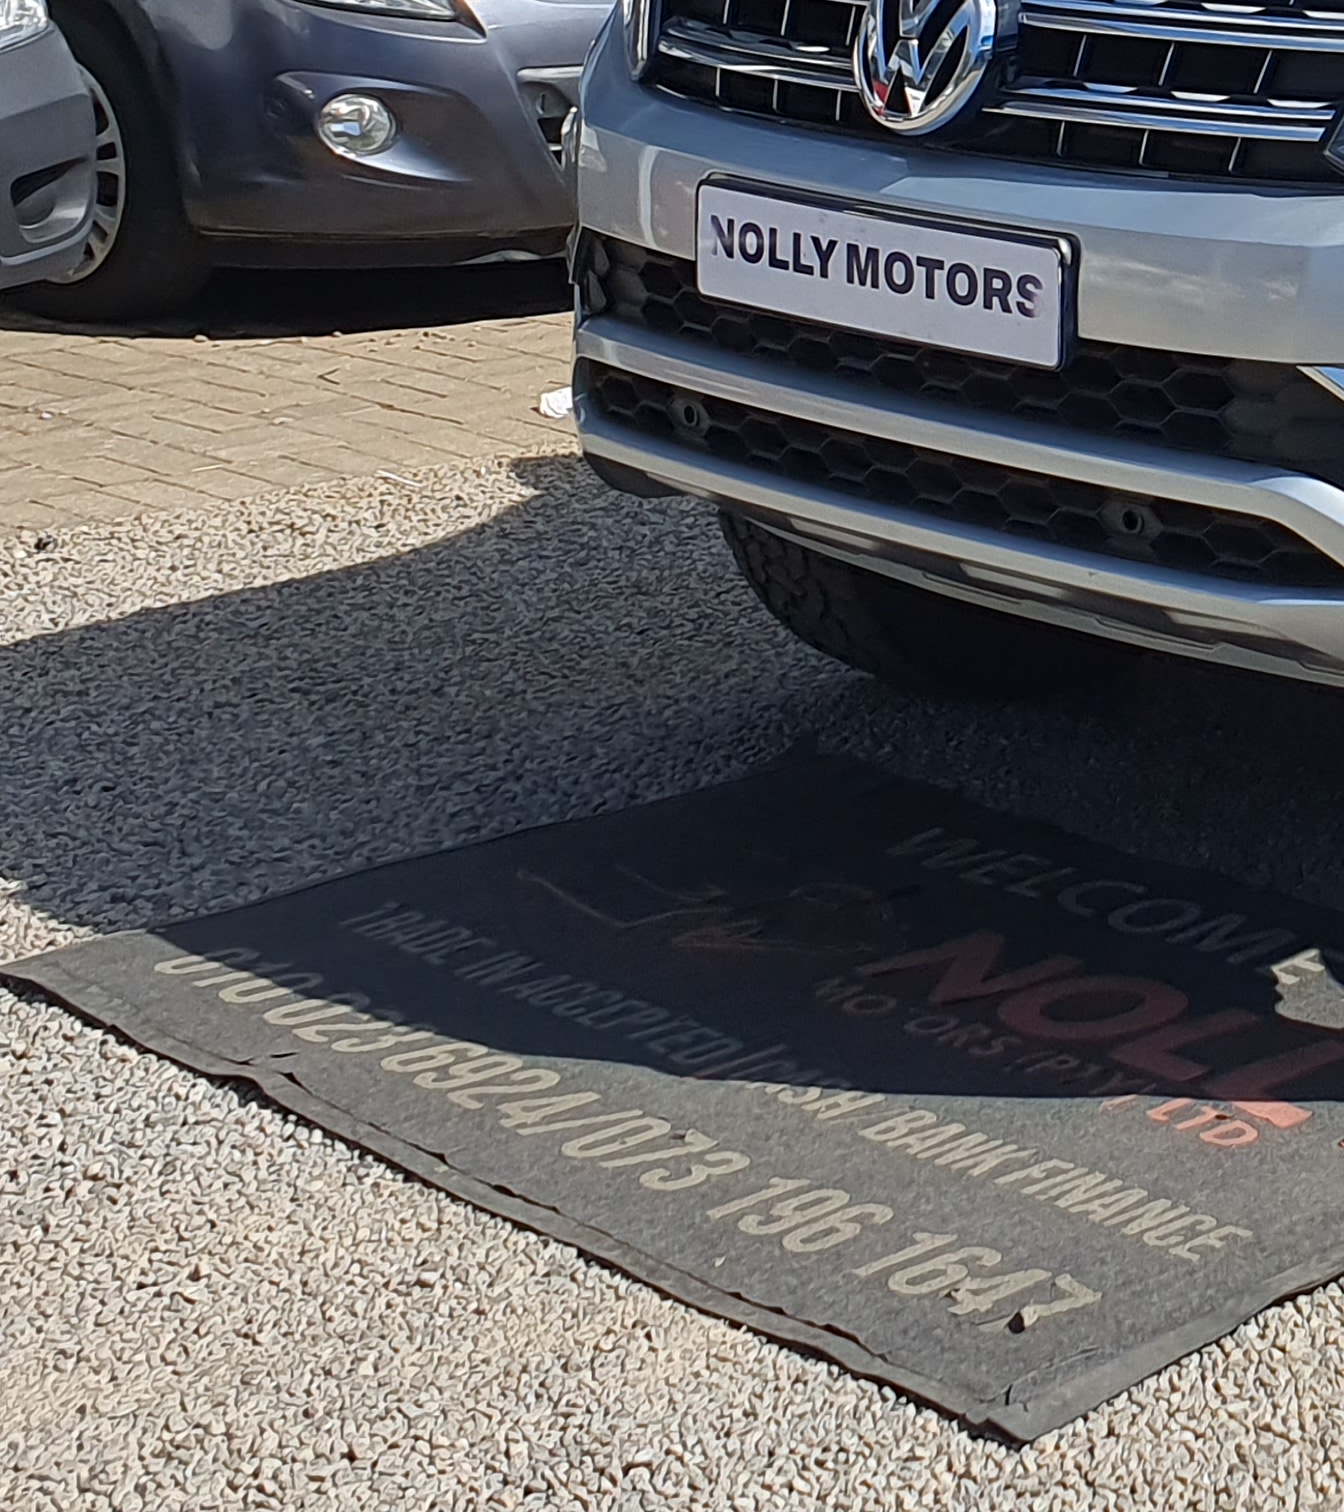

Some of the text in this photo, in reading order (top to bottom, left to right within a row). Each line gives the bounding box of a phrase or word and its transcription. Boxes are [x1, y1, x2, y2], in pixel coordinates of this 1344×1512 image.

[710, 214, 1044, 319] NOLLY MOTORS
[453, 948, 545, 987] IN
[994, 1158, 1254, 1264] FINANCE
[812, 975, 1023, 1057] MOORS
[154, 946, 1102, 1332] 010 023 6924/073 196 1647
